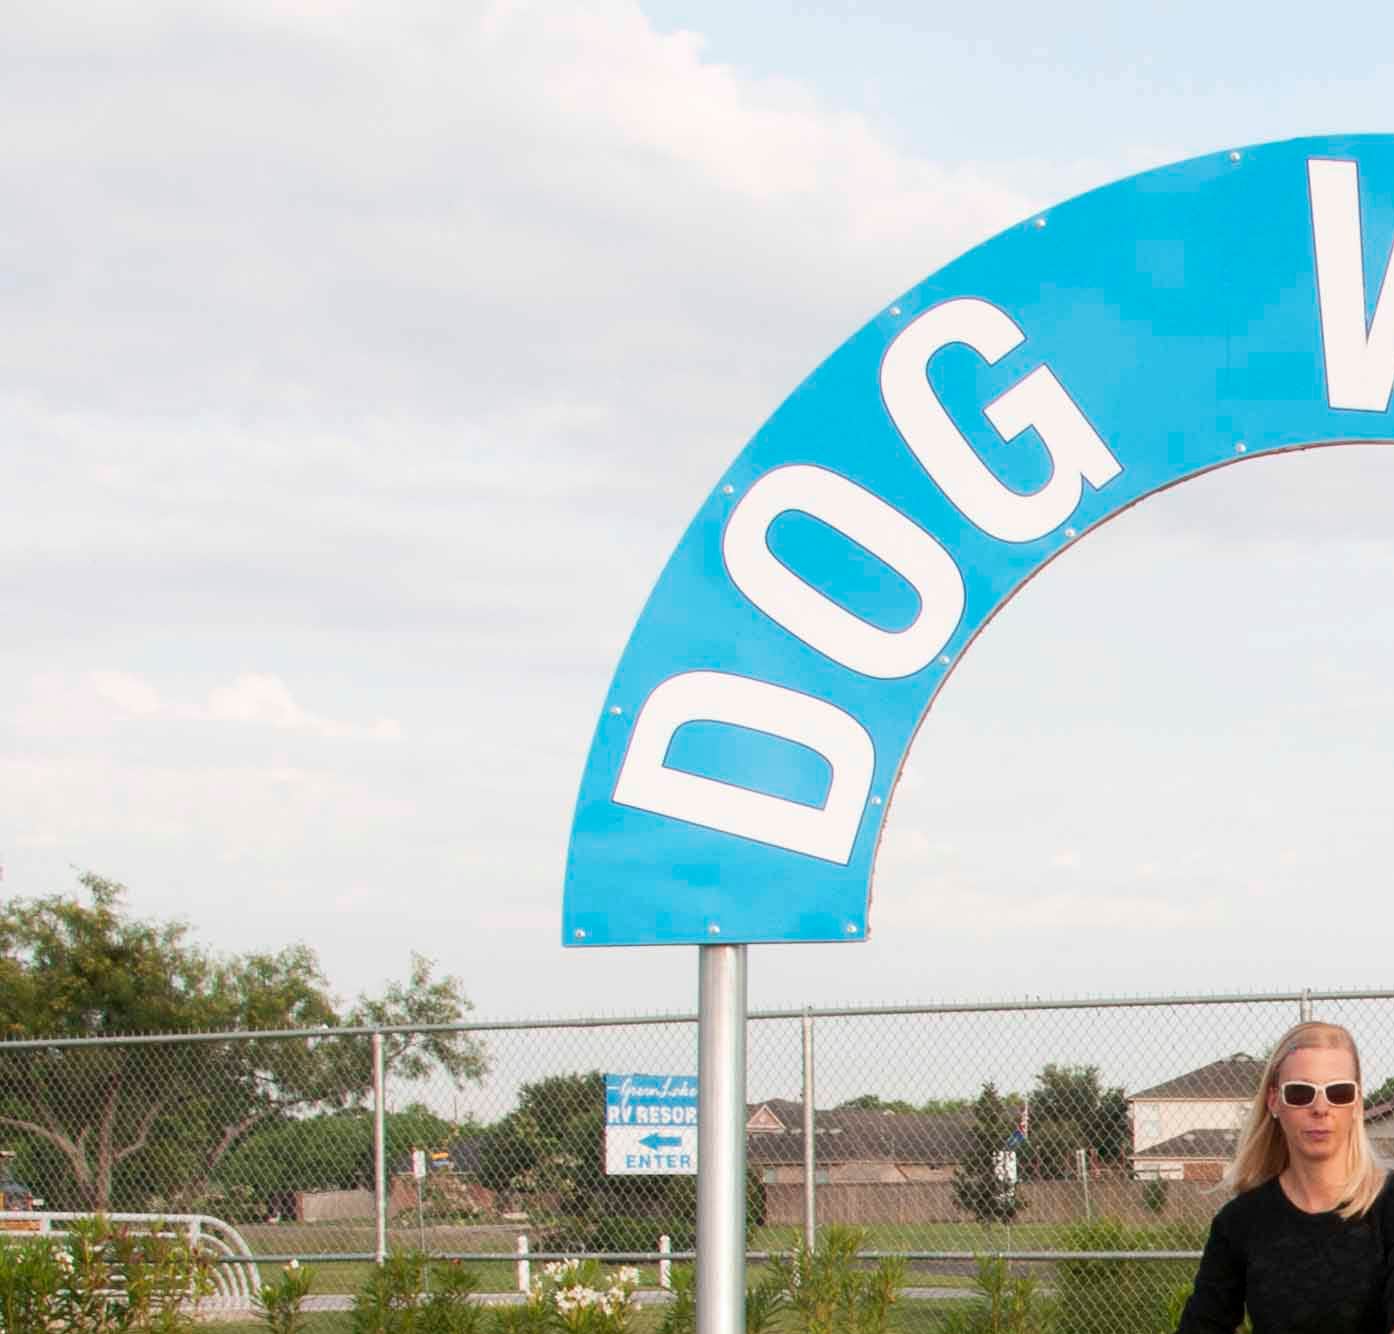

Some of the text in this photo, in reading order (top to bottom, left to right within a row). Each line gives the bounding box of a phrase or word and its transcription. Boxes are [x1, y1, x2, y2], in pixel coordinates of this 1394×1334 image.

[612, 298, 1122, 865] DOG
[607, 1105, 698, 1123] RV RESOR
[626, 1155, 690, 1168] ENTER
